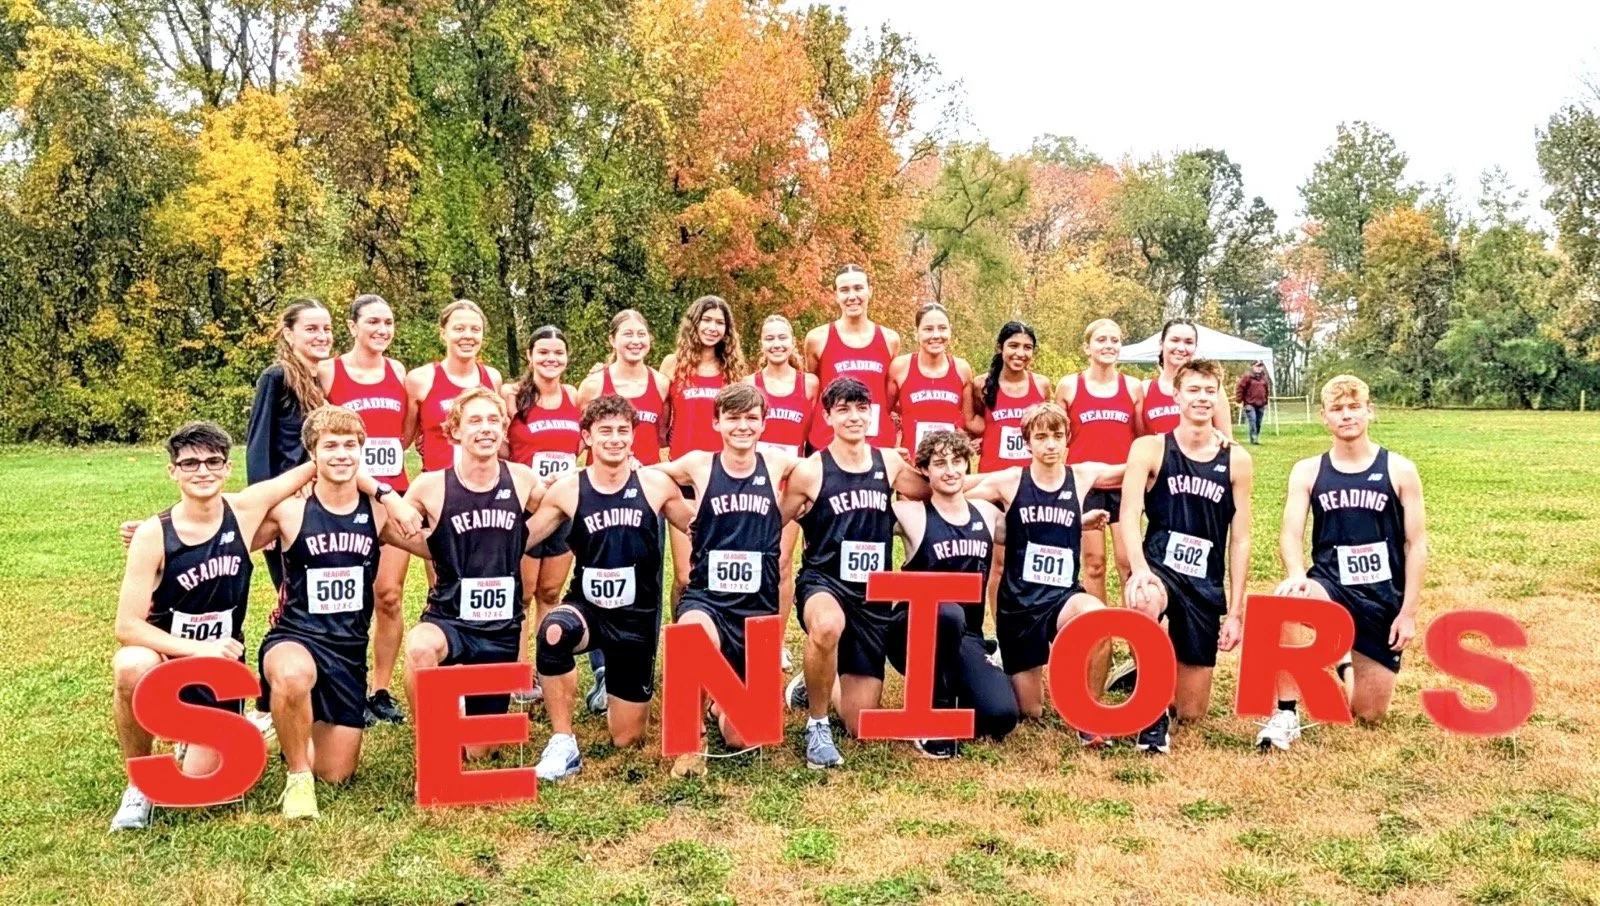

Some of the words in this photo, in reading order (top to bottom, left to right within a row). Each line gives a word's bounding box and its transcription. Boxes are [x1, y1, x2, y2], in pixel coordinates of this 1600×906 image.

[834, 359, 884, 373] READING
[909, 390, 960, 404] READING
[992, 407, 1026, 422] READ
[1079, 409, 1130, 424] READING
[1148, 405, 1180, 420] READ
[527, 419, 581, 434] READING
[1006, 434, 1024, 451] 50
[364, 447, 397, 466] 509
[1167, 474, 1225, 503] READING
[710, 493, 771, 516] READING
[828, 489, 888, 515] READING
[1318, 488, 1389, 512] READING
[451, 508, 517, 535] READING
[583, 507, 643, 534] READING
[1019, 505, 1076, 527] READING
[305, 532, 373, 556] READING
[932, 539, 989, 560] READING
[1173, 542, 1204, 567] 502
[716, 561, 753, 582] 506
[847, 551, 880, 572] 503
[1031, 553, 1065, 576] 501
[1346, 553, 1382, 574] 509
[176, 555, 242, 592] READING
[323, 569, 351, 578] READING
[316, 578, 356, 601] 508
[470, 588, 507, 610] 505
[590, 578, 627, 599] 507
[180, 621, 223, 640] 504
[126, 571, 1535, 806] SENIORS
